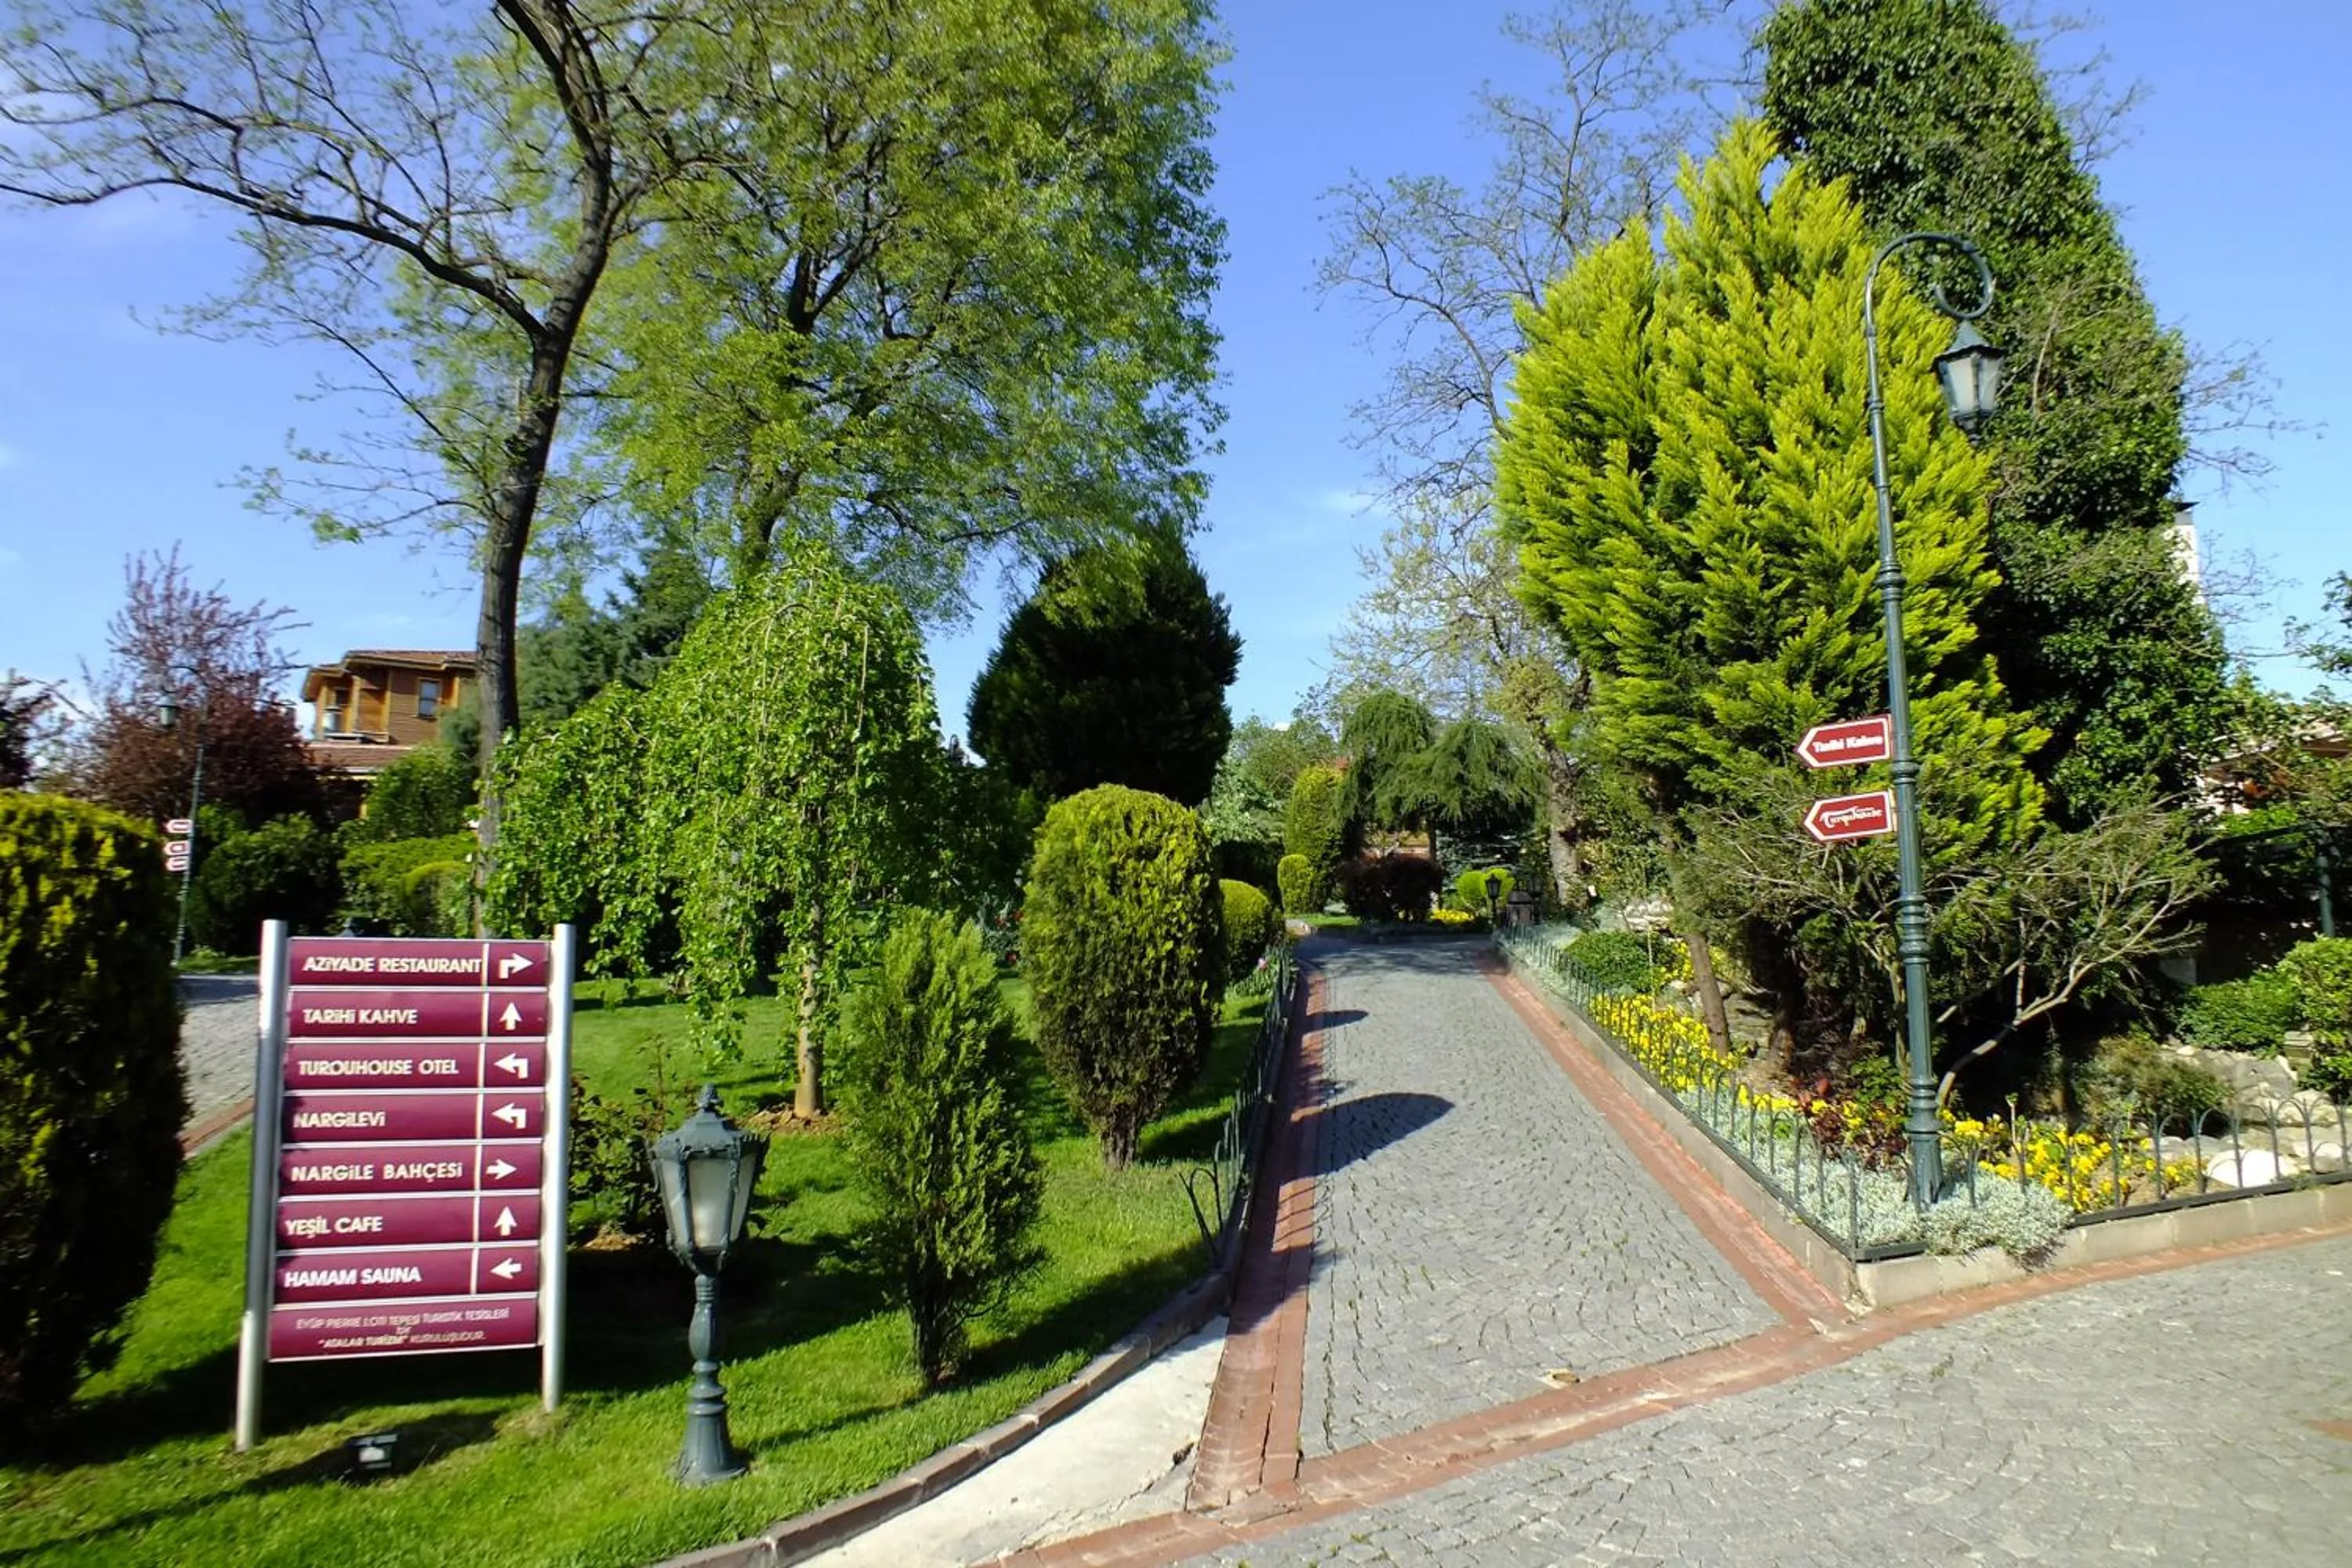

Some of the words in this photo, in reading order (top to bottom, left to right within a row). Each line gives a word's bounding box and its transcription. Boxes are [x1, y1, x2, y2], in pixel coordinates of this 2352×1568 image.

[378, 958, 482, 973] RESTAURANT
[358, 1009, 418, 1024] KAHVE
[418, 1059, 459, 1074] OTEL
[334, 1216, 383, 1233] CAFE
[284, 1269, 357, 1287] HAMAM
[361, 1266, 422, 1284] SAUNA
